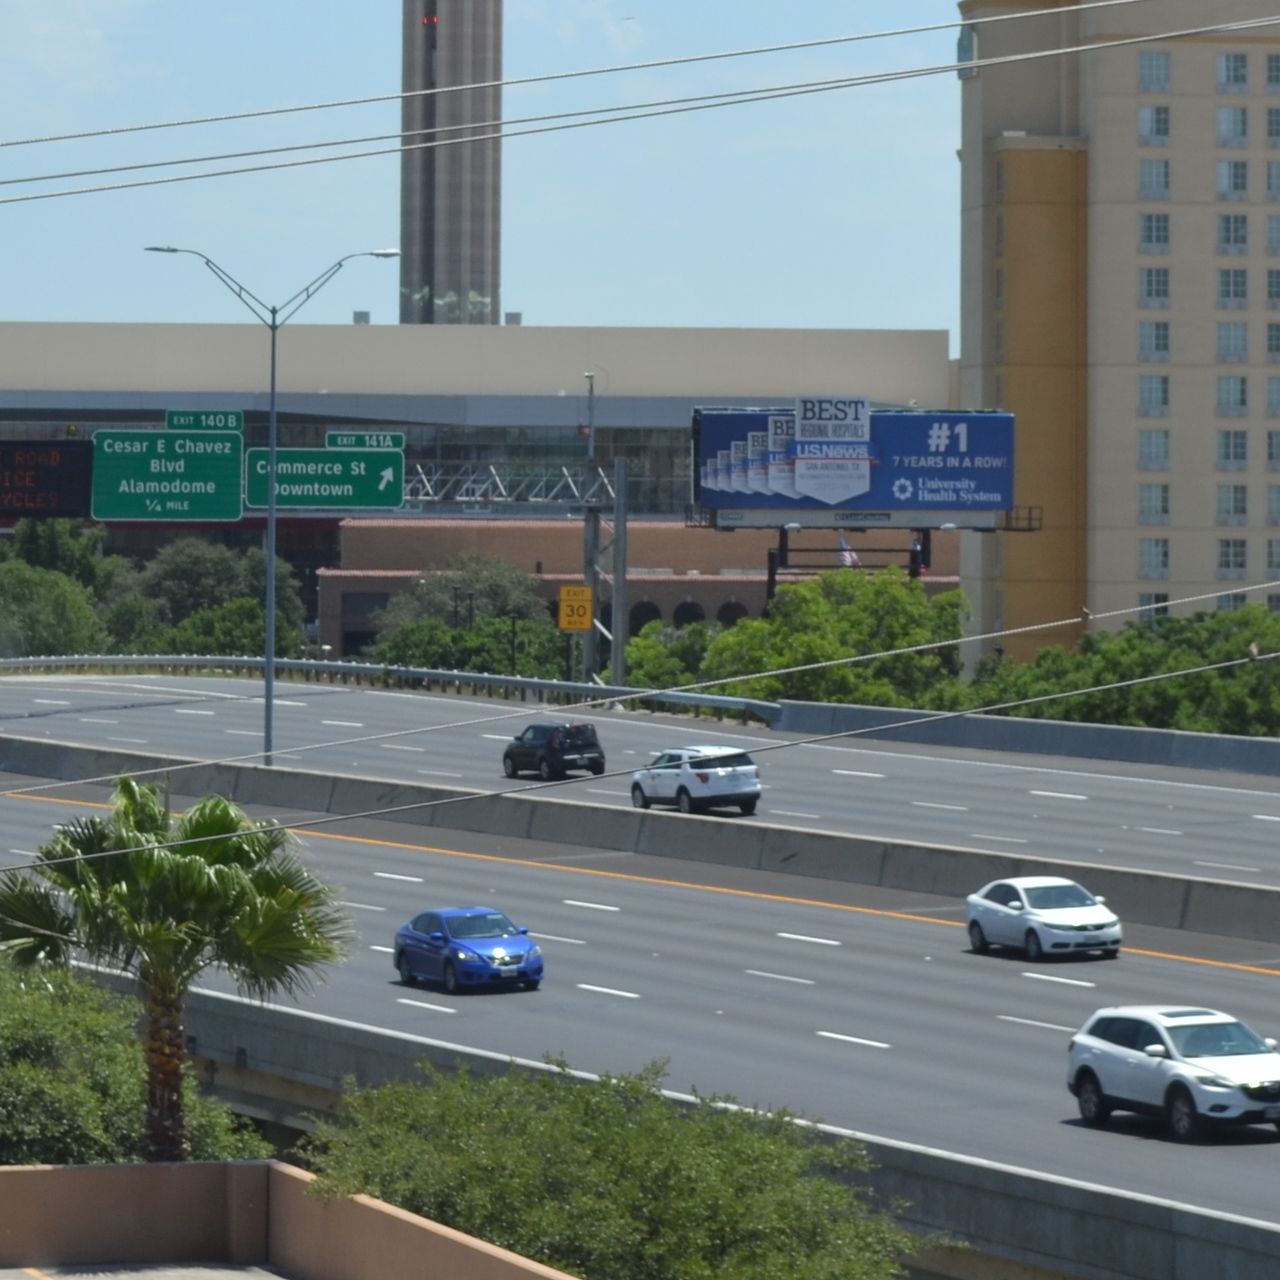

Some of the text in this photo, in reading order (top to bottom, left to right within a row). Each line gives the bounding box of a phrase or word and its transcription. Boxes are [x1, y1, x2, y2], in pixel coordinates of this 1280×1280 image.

[801, 399, 865, 422] BEST
[173, 416, 194, 426] EXIT
[337, 436, 356, 446] EXIT
[928, 422, 967, 452] #1
[103, 439, 232, 454] Cesar E Chavez
[15, 450, 62, 467] ROAD
[150, 458, 185, 473] Blvd
[902, 456, 944, 469] YEARS
[946, 456, 959, 469] IN
[962, 456, 972, 469] A
[351, 460, 366, 476] St
[118, 479, 217, 494] Alamodome
[917, 477, 977, 491] University
[917, 490, 1002, 504] Health System
[166, 500, 190, 511] MILE
[565, 604, 587, 618] 30
